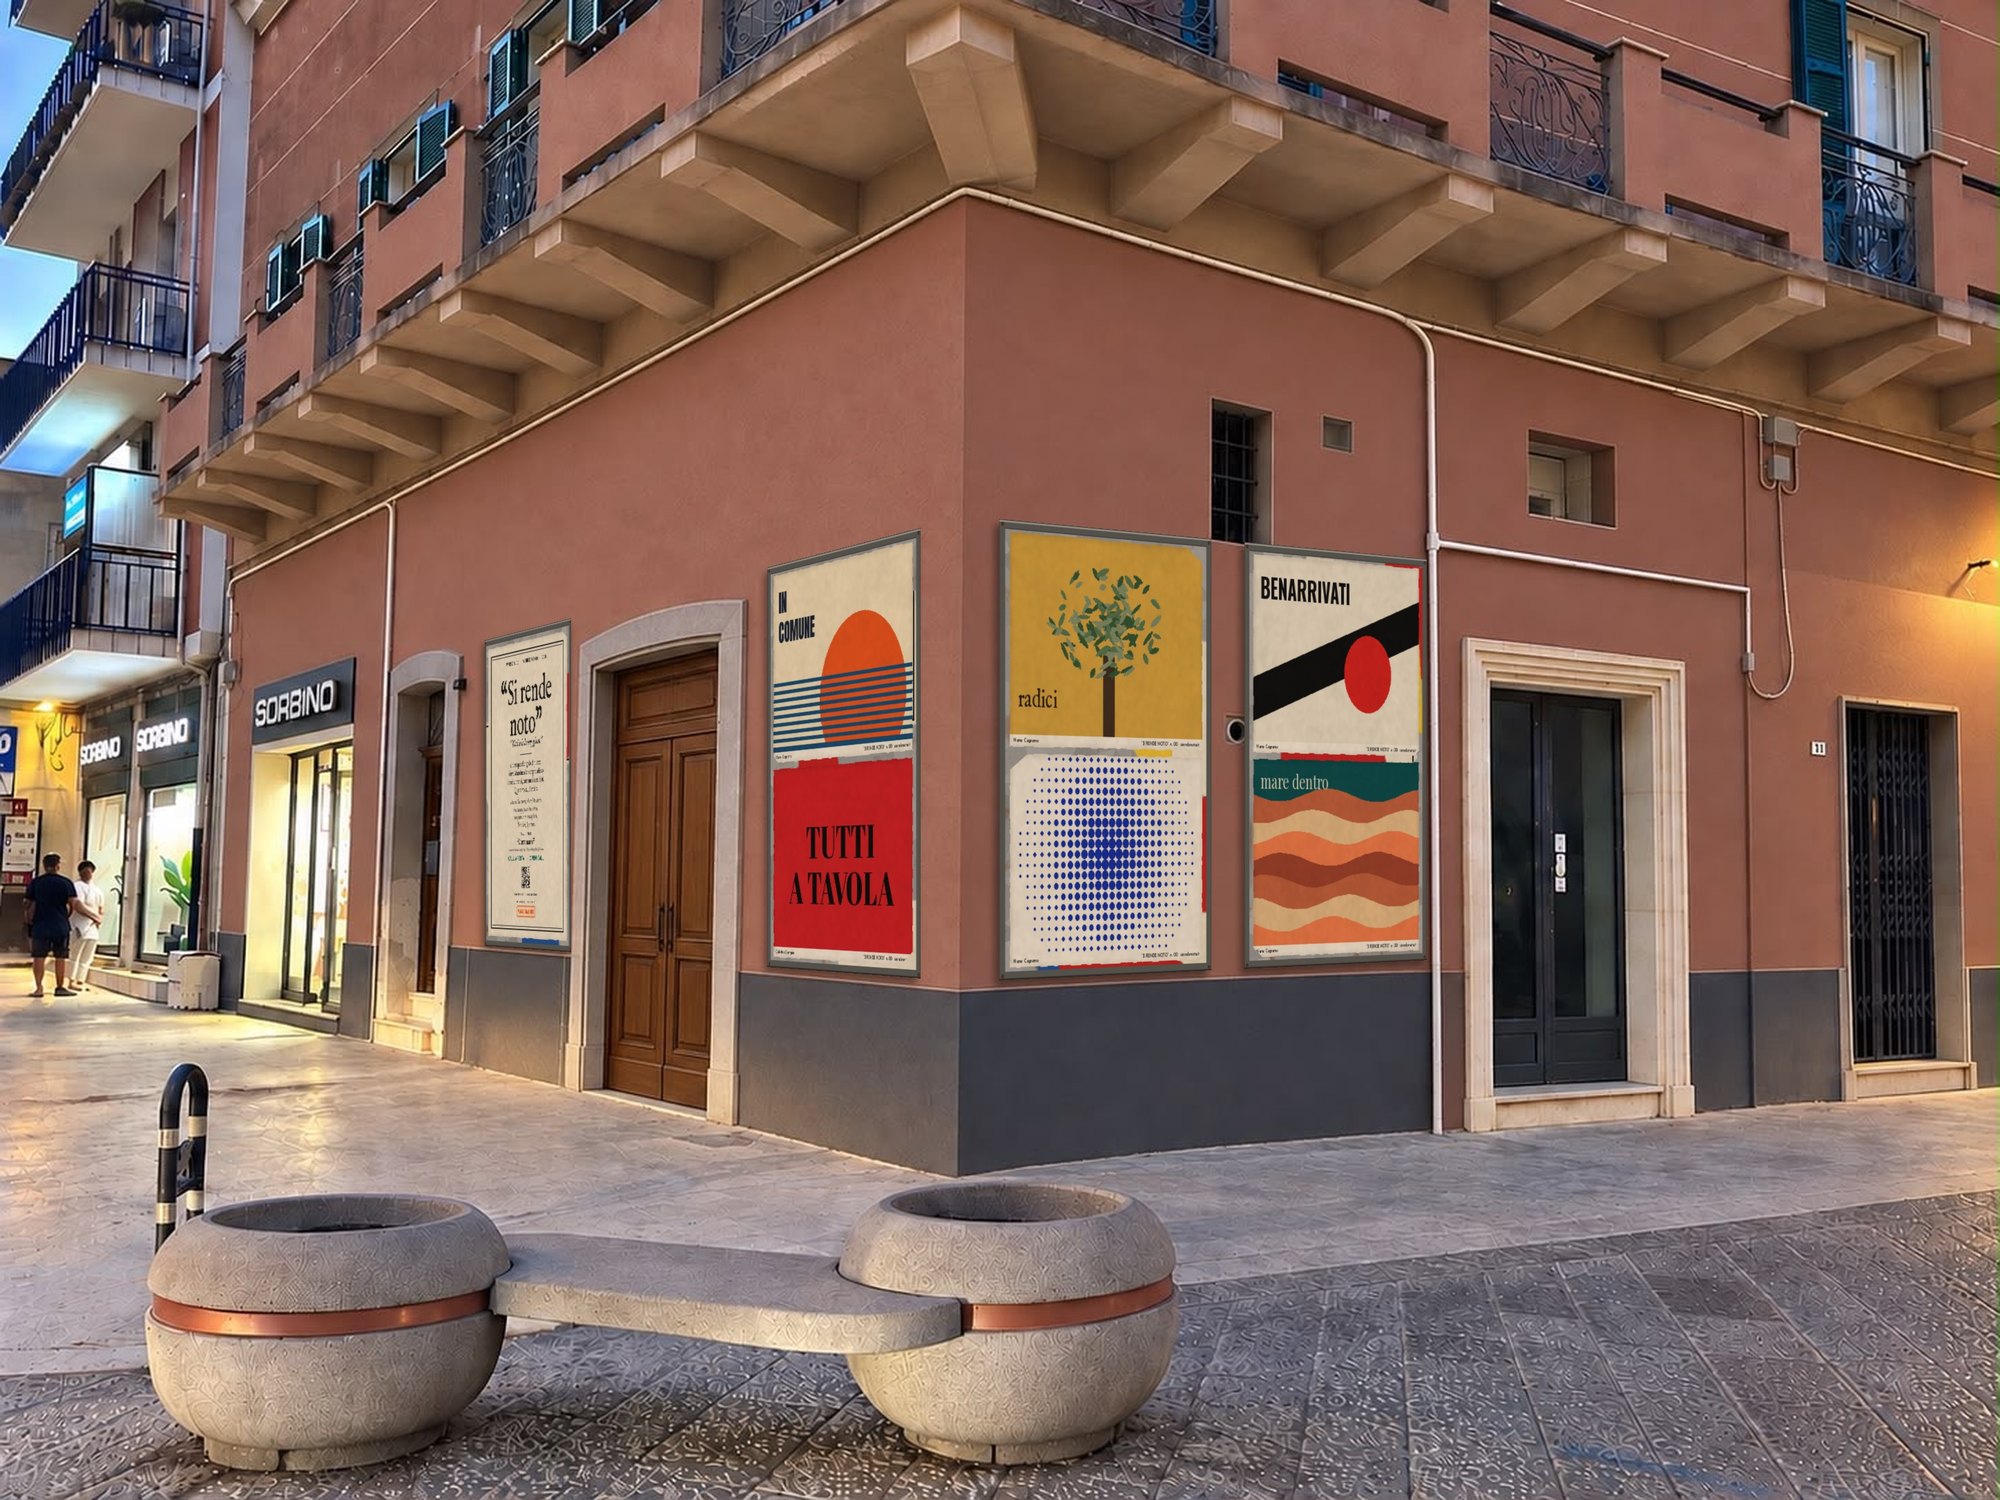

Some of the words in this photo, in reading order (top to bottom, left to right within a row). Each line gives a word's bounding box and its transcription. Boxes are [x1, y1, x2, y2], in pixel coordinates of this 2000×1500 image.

[778, 590, 787, 614] IN
[1261, 576, 1350, 606] BENARRIVATI
[779, 614, 815, 643] COMUNE
[520, 672, 552, 703] rende
[1018, 687, 1058, 709] radici
[255, 679, 335, 727] SORBINO
[136, 718, 188, 752] SORBINO
[1815, 743, 1824, 754] 11
[80, 736, 121, 766] SORBINO
[1260, 777, 1290, 790] mare
[1292, 773, 1329, 790] dentro
[806, 824, 875, 860] TUTTI
[789, 871, 804, 905] A
[807, 871, 895, 906] TAVOLA
